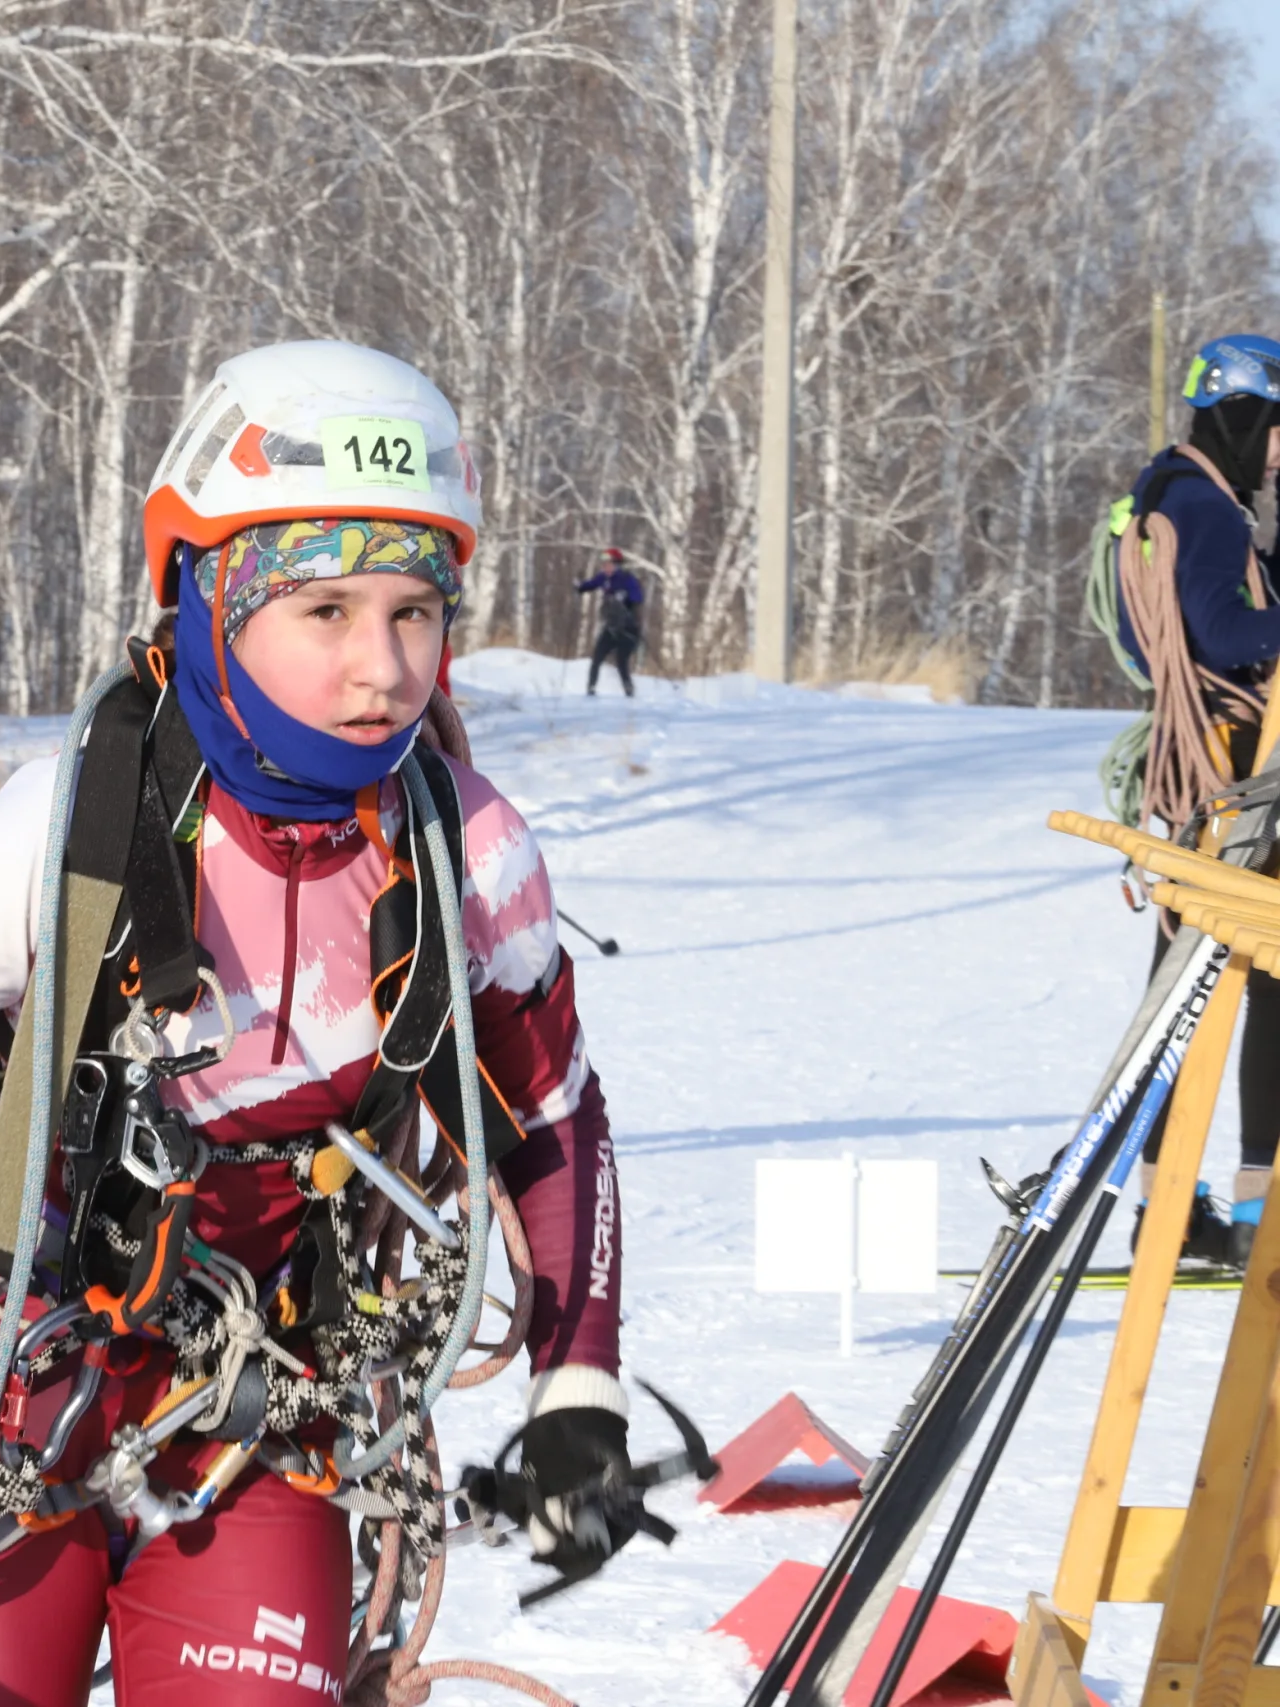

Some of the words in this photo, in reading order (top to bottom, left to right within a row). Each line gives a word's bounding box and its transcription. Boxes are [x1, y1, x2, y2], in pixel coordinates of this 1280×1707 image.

[1216, 343, 1262, 374] VENTO
[344, 435, 415, 476] 142
[589, 1139, 616, 1301] NORDSKI
[179, 1641, 343, 1706] NORDSKI
